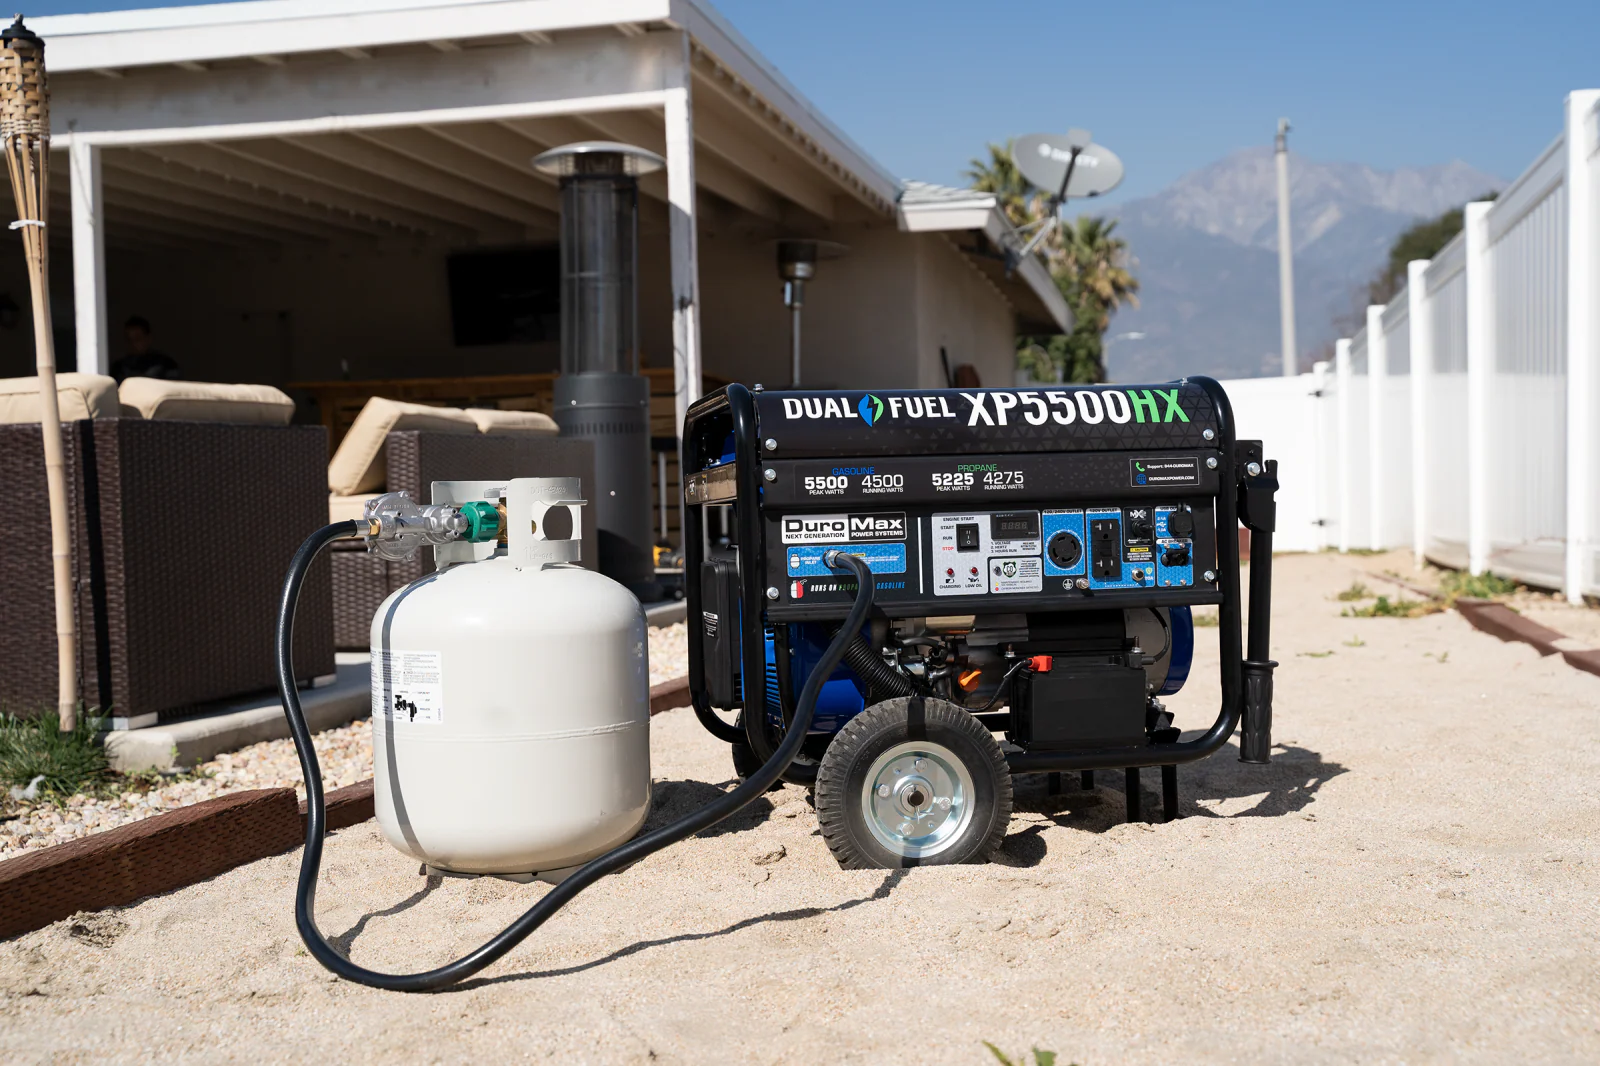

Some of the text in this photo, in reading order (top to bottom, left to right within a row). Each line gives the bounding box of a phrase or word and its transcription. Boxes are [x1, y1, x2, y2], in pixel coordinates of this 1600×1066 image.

[782, 389, 1190, 426] DUAL FUEL XP5500HX
[832, 466, 875, 476] GASOLINE
[957, 463, 998, 472] PROPANE
[804, 474, 904, 490] 5500 4500
[931, 470, 1024, 486] 5225 4275
[810, 581, 906, 592] RUNS ON PROPA GASOLINE
